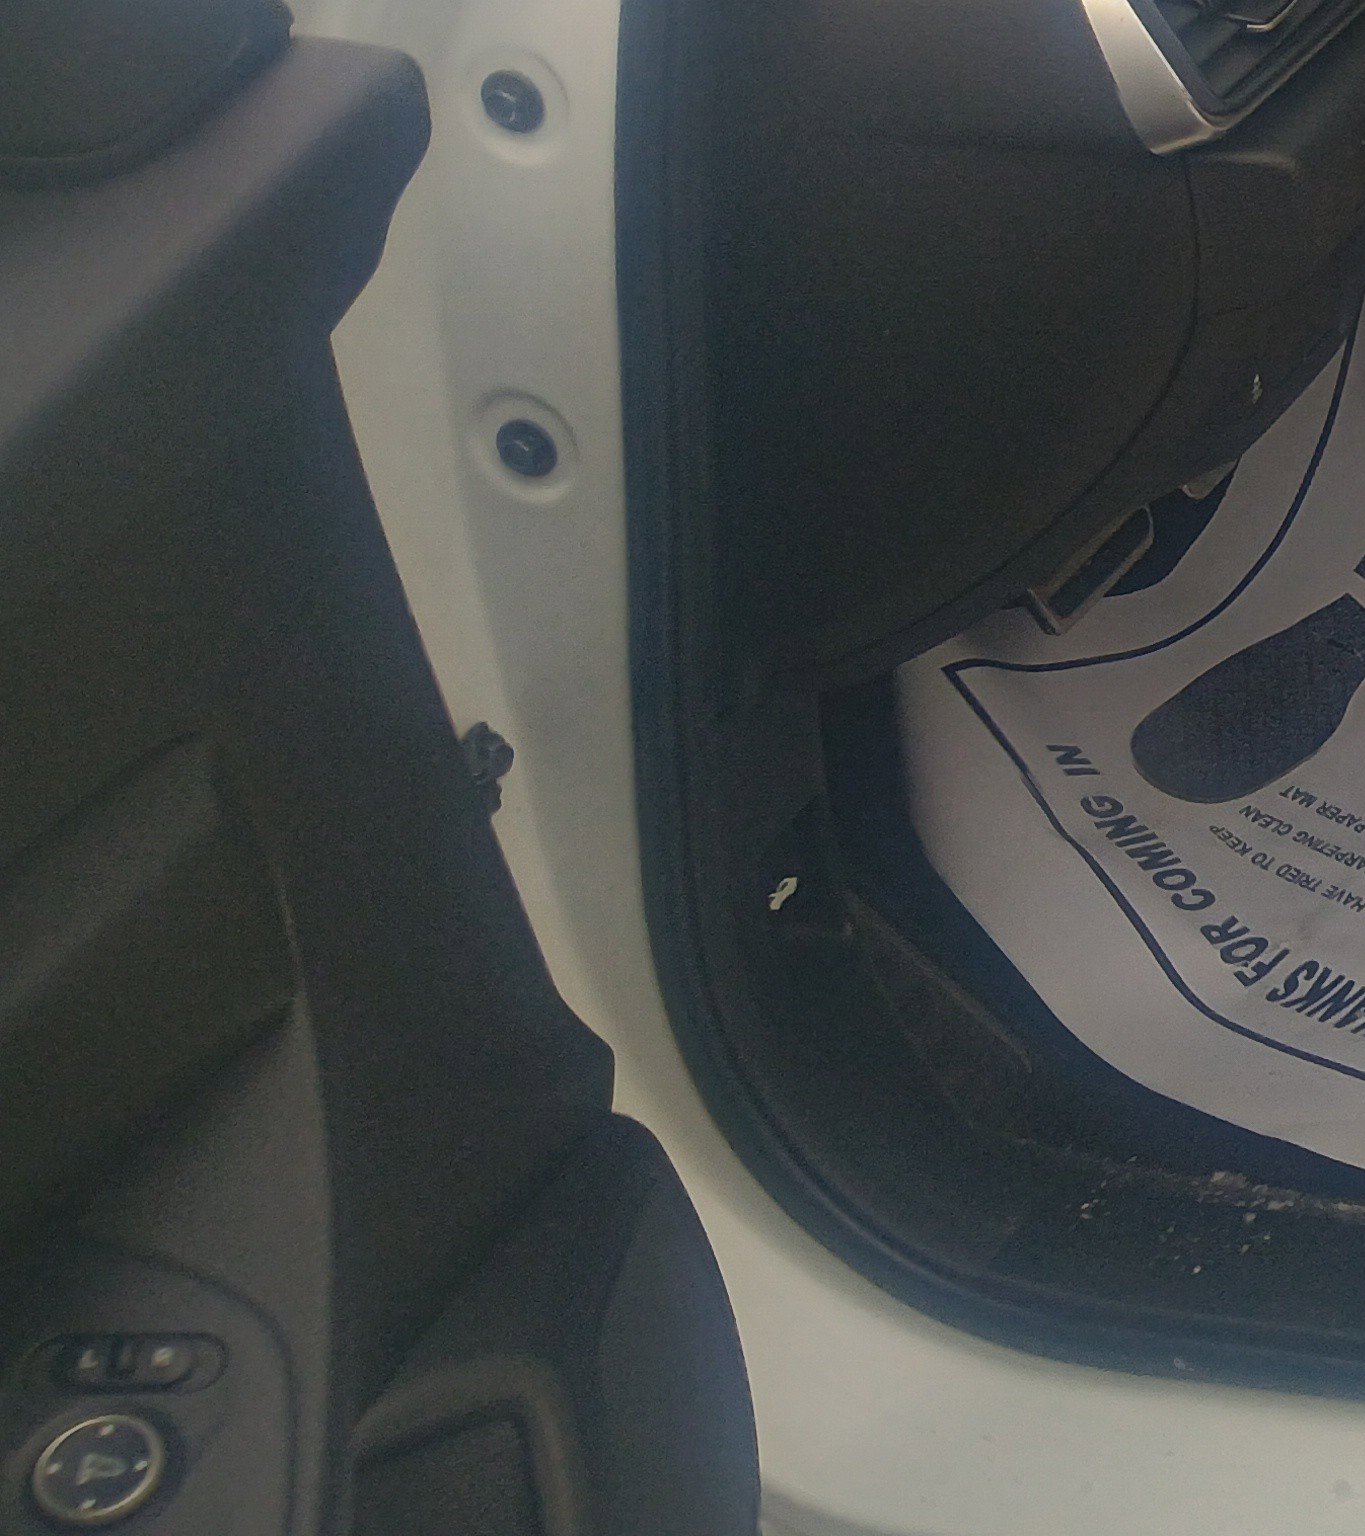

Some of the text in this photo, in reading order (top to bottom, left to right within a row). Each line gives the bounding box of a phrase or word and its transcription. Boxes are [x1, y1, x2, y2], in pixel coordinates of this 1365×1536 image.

[1046, 745, 1100, 776] IN
[1278, 785, 1318, 808] MAT
[1239, 805, 1293, 836] CLEAN
[1081, 794, 1216, 911] COMING
[1209, 825, 1252, 856] KEEP
[1251, 853, 1275, 871] TO
[1276, 863, 1322, 892] TRIED
[1200, 916, 1289, 987] FOR
